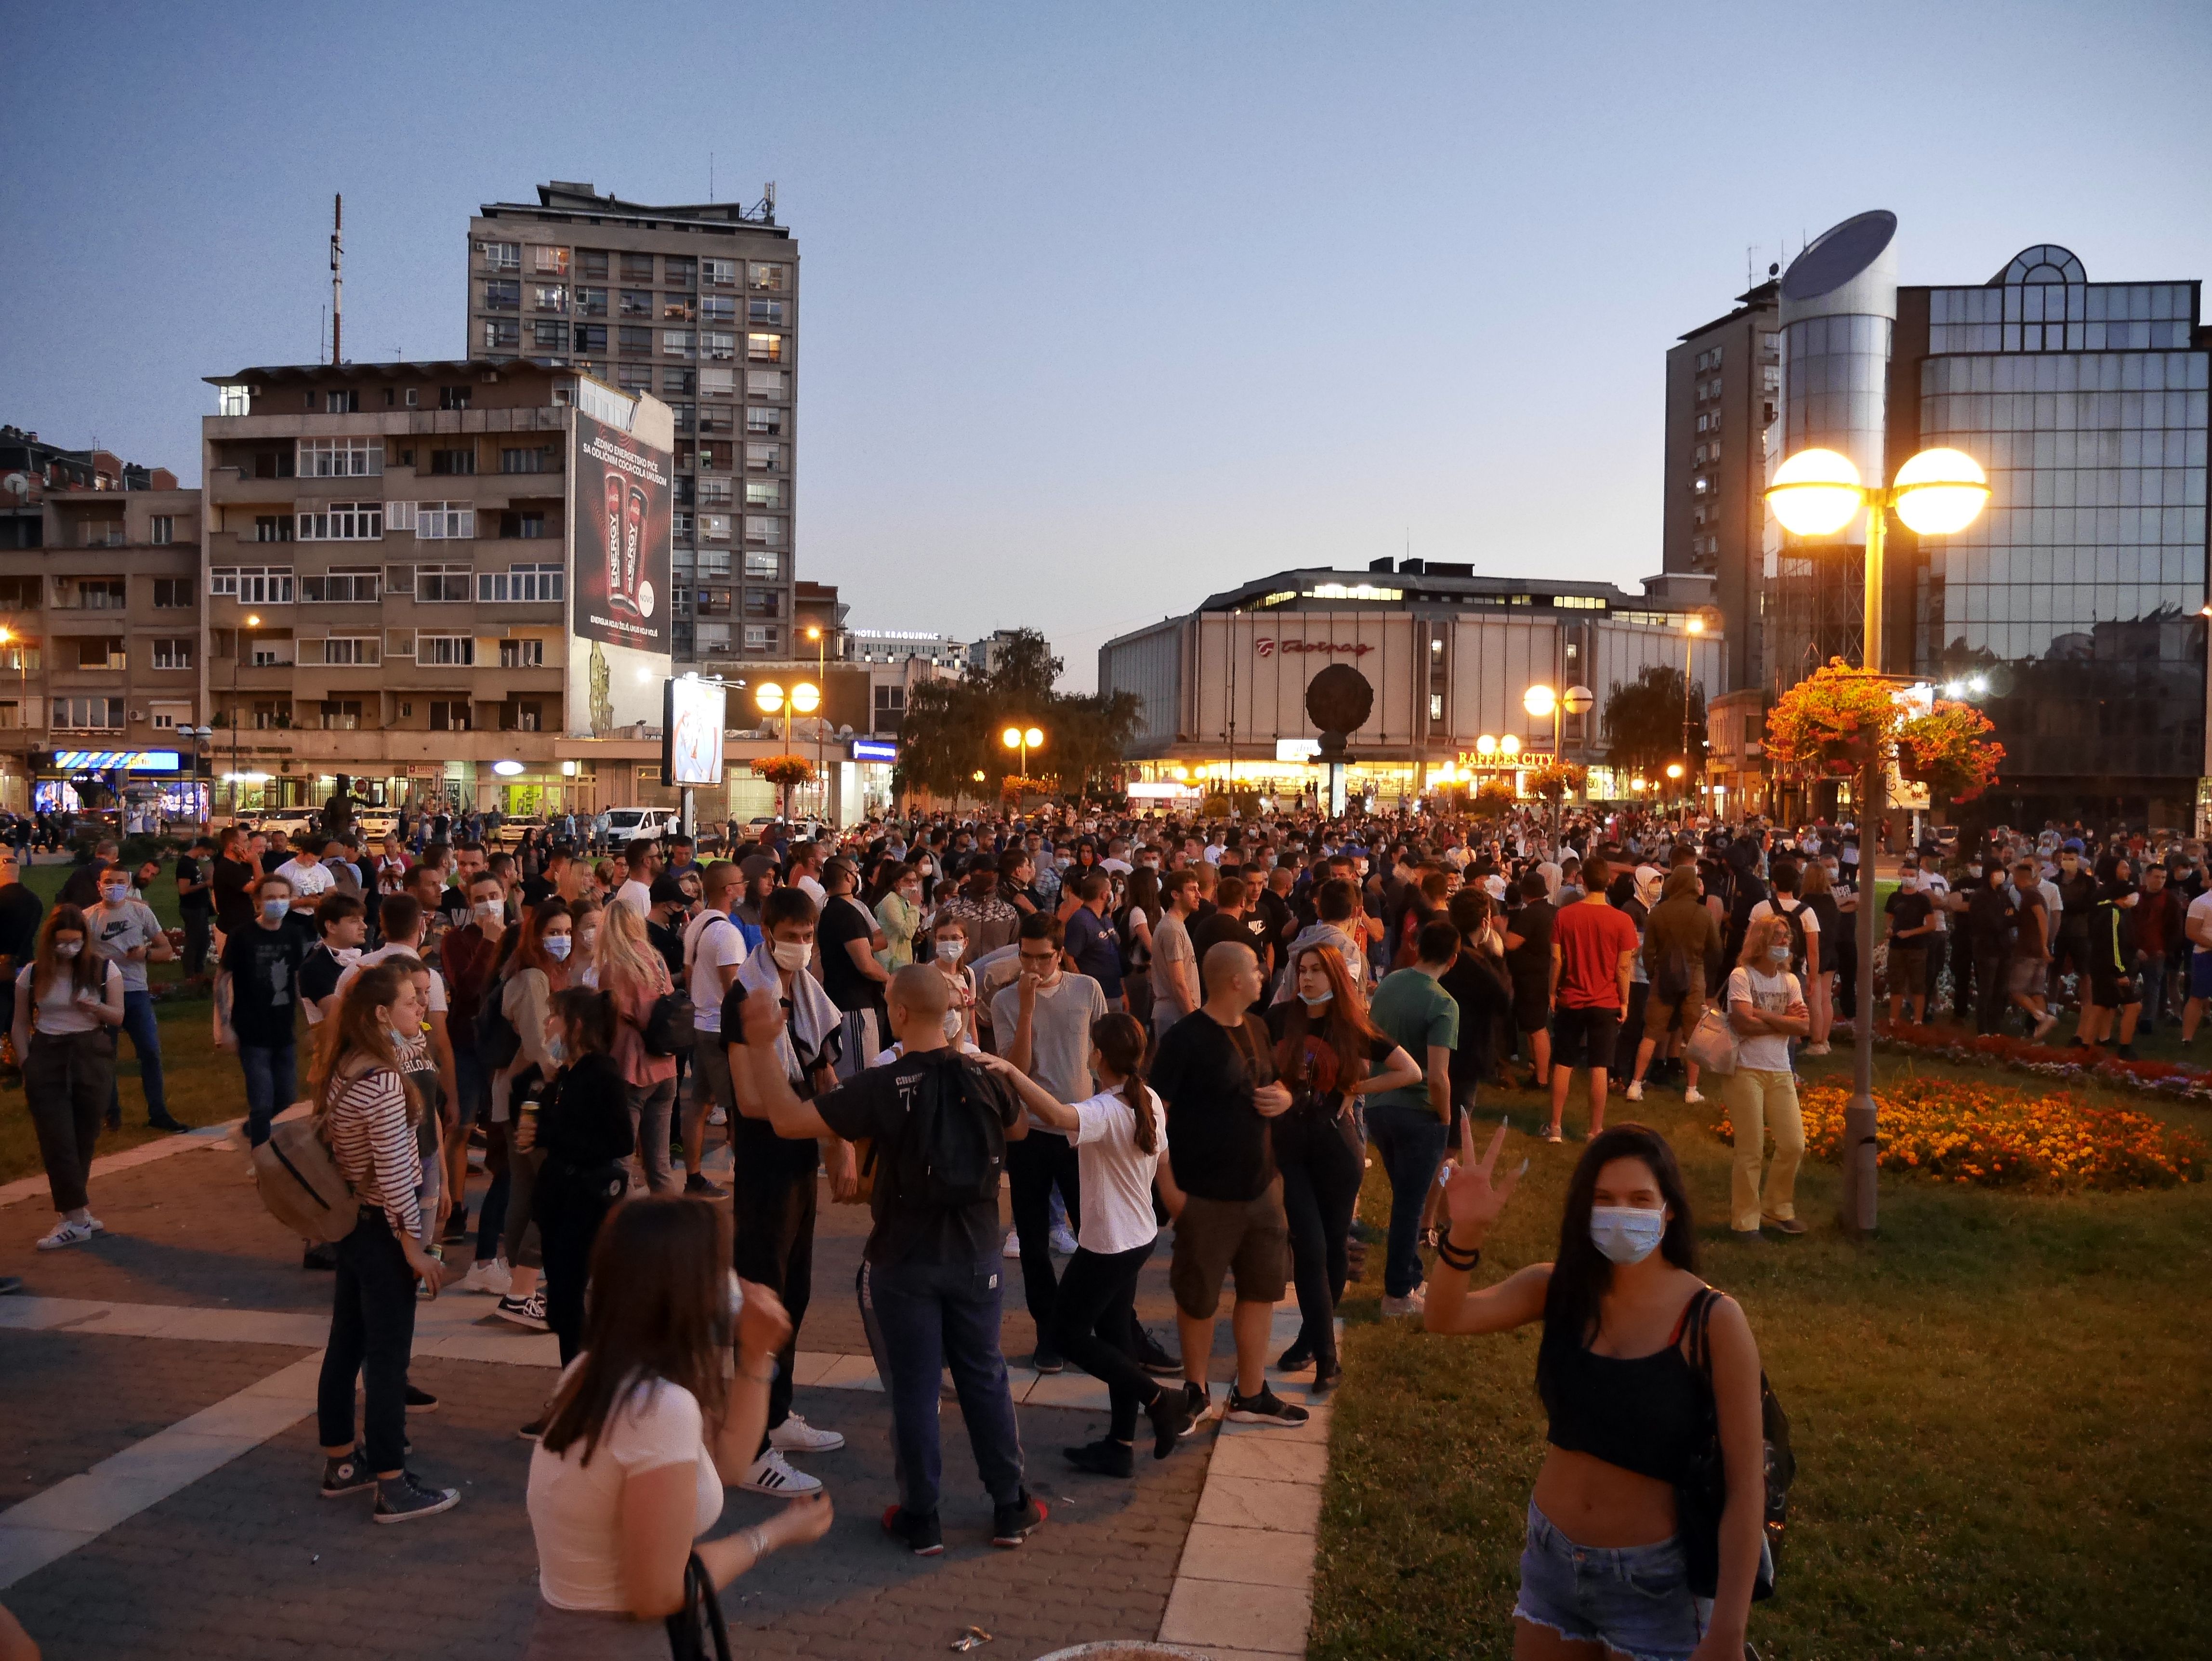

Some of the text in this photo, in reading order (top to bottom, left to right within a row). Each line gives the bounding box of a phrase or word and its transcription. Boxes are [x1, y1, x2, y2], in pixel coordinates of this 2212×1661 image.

[593, 437, 658, 473] JEDINO ENERGETSKO PIĆE
[583, 443, 591, 455] SA
[646, 472, 667, 487] UKUSOM
[640, 594, 653, 604] NOVO
[591, 615, 608, 626] ENERGIJA
[630, 625, 639, 633] UKUS
[855, 630, 939, 640] HOTEL KRAGUJEVAC
[1297, 744, 1312, 752] dm
[1458, 751, 1555, 766] RAFFLES CITY
[105, 920, 129, 932] NIKE
